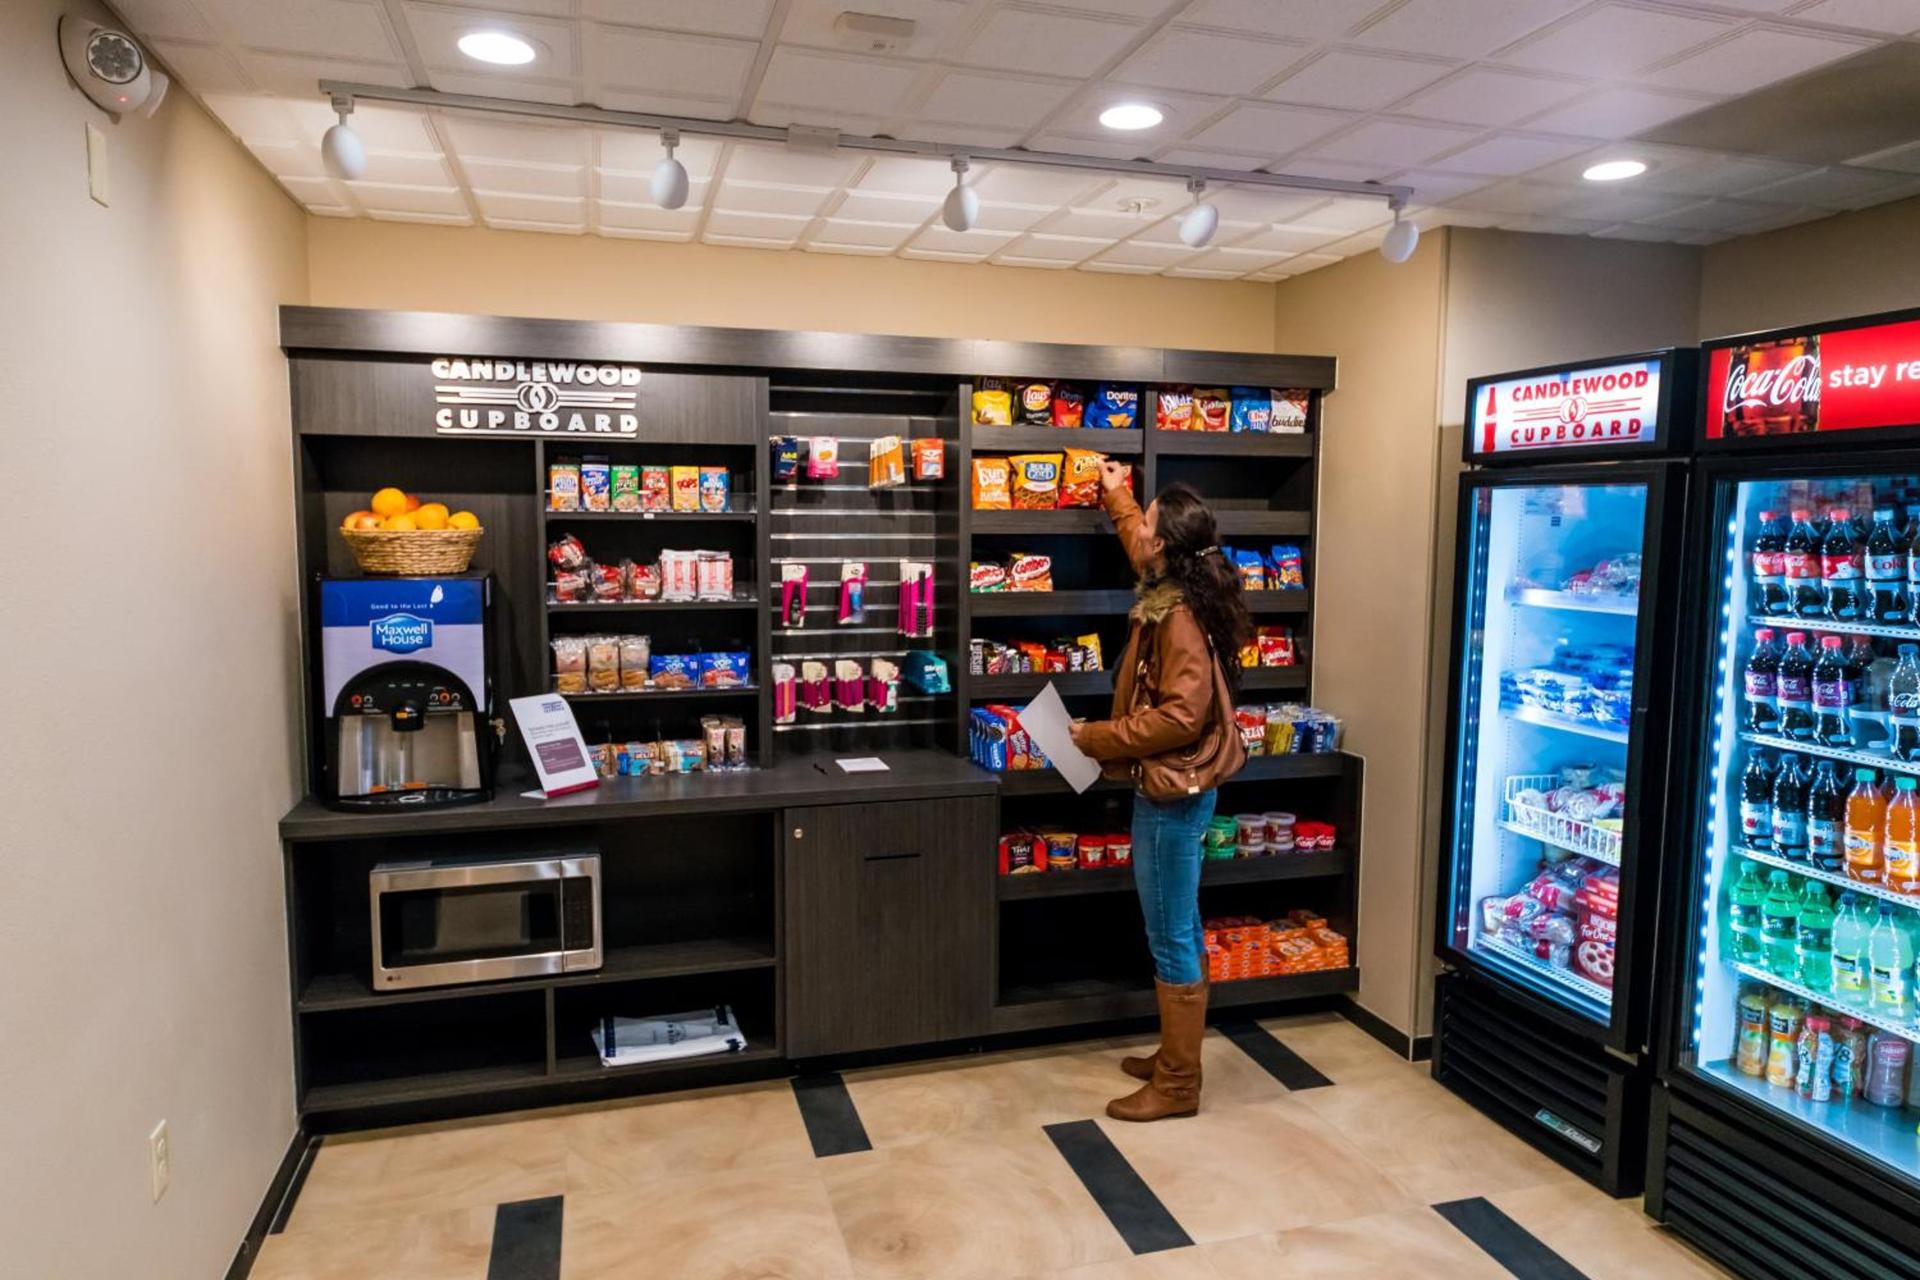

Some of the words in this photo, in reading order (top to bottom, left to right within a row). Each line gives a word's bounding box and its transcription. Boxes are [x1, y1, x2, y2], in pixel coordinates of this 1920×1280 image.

[431, 358, 642, 386] CANDLEWOOD
[1724, 354, 1822, 413] Coca-Cola
[1828, 364, 1888, 389] stay
[1106, 391, 1138, 401] Doritos
[1511, 370, 1649, 402] CANDLEWOOD
[435, 408, 639, 433] CUPBOARD
[1510, 418, 1643, 444] CUPBOARD
[1014, 558, 1050, 575] Combos
[375, 623, 428, 636] Maxwell
[382, 635, 424, 645] House
